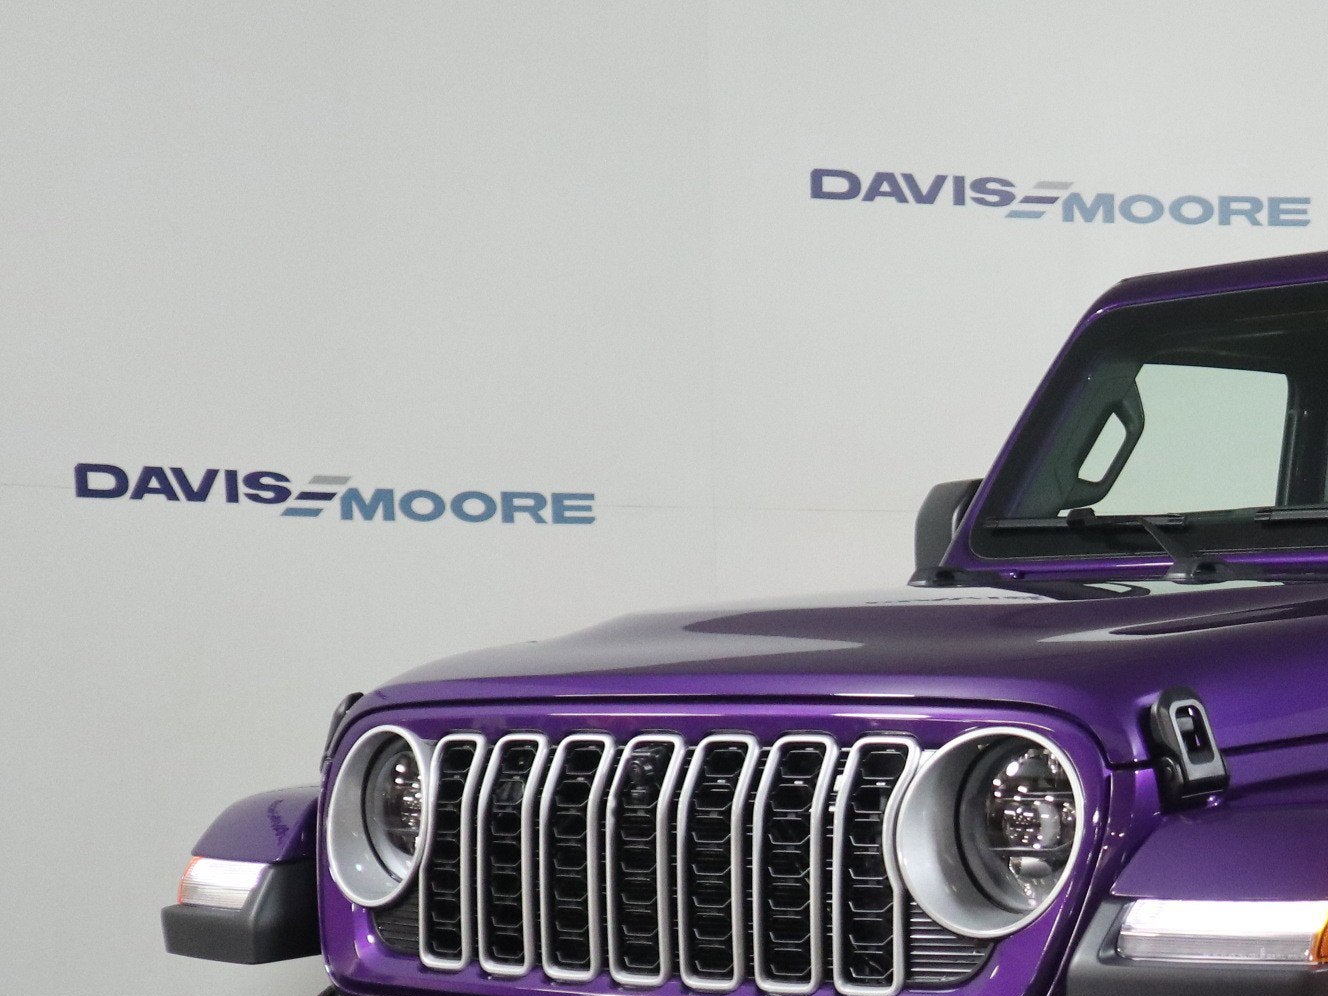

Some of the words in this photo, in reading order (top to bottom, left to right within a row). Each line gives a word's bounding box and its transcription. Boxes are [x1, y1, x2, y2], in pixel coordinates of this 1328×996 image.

[809, 167, 1017, 208] DAVIS
[1062, 192, 1311, 227] MOORE
[73, 462, 293, 506] DAVIS
[339, 487, 597, 525] MOORE
